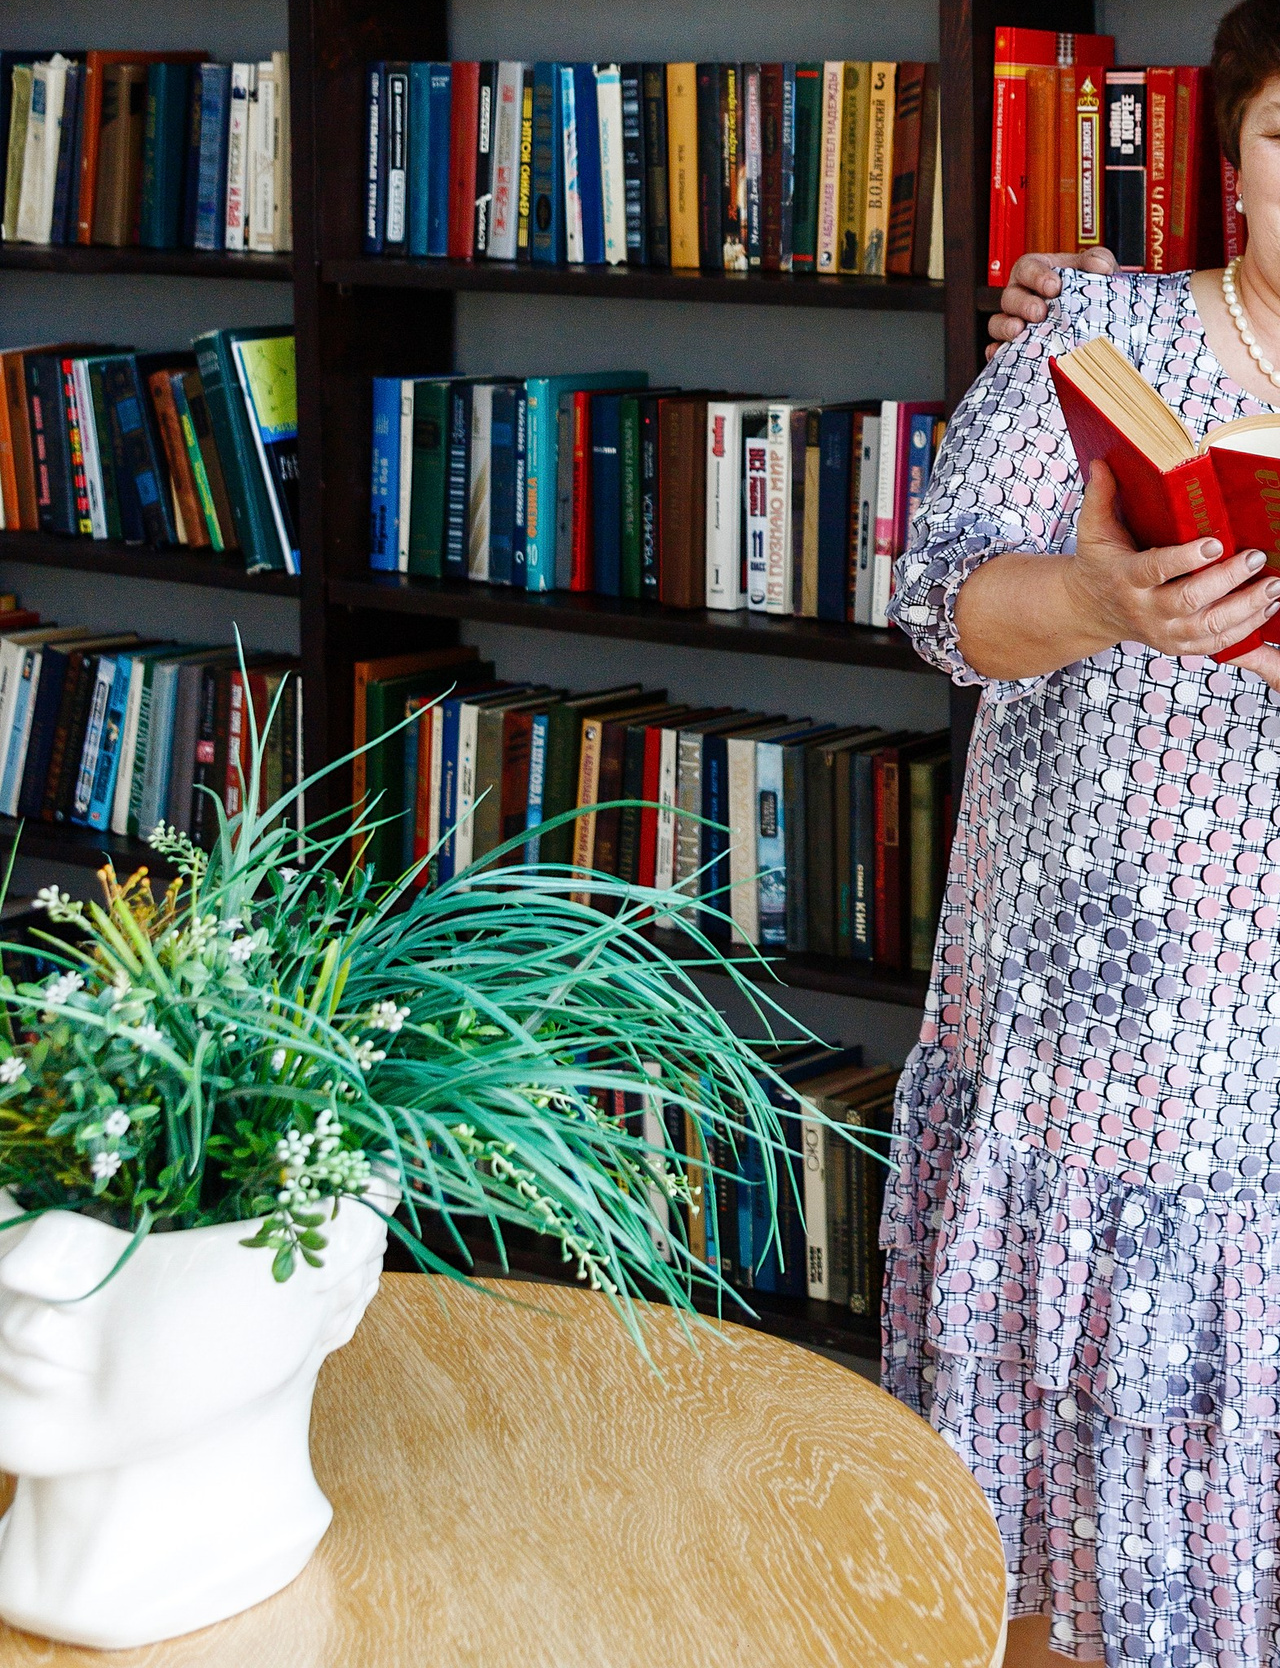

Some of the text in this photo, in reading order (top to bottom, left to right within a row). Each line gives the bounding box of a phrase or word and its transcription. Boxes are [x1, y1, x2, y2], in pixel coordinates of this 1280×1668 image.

[1082, 119, 1094, 158] ДЕМОН
[1109, 101, 1123, 148] ВОЙНА
[1121, 93, 1136, 155] В КОРЕЕ
[1082, 169, 1093, 231] АНЖЕЛИКА
